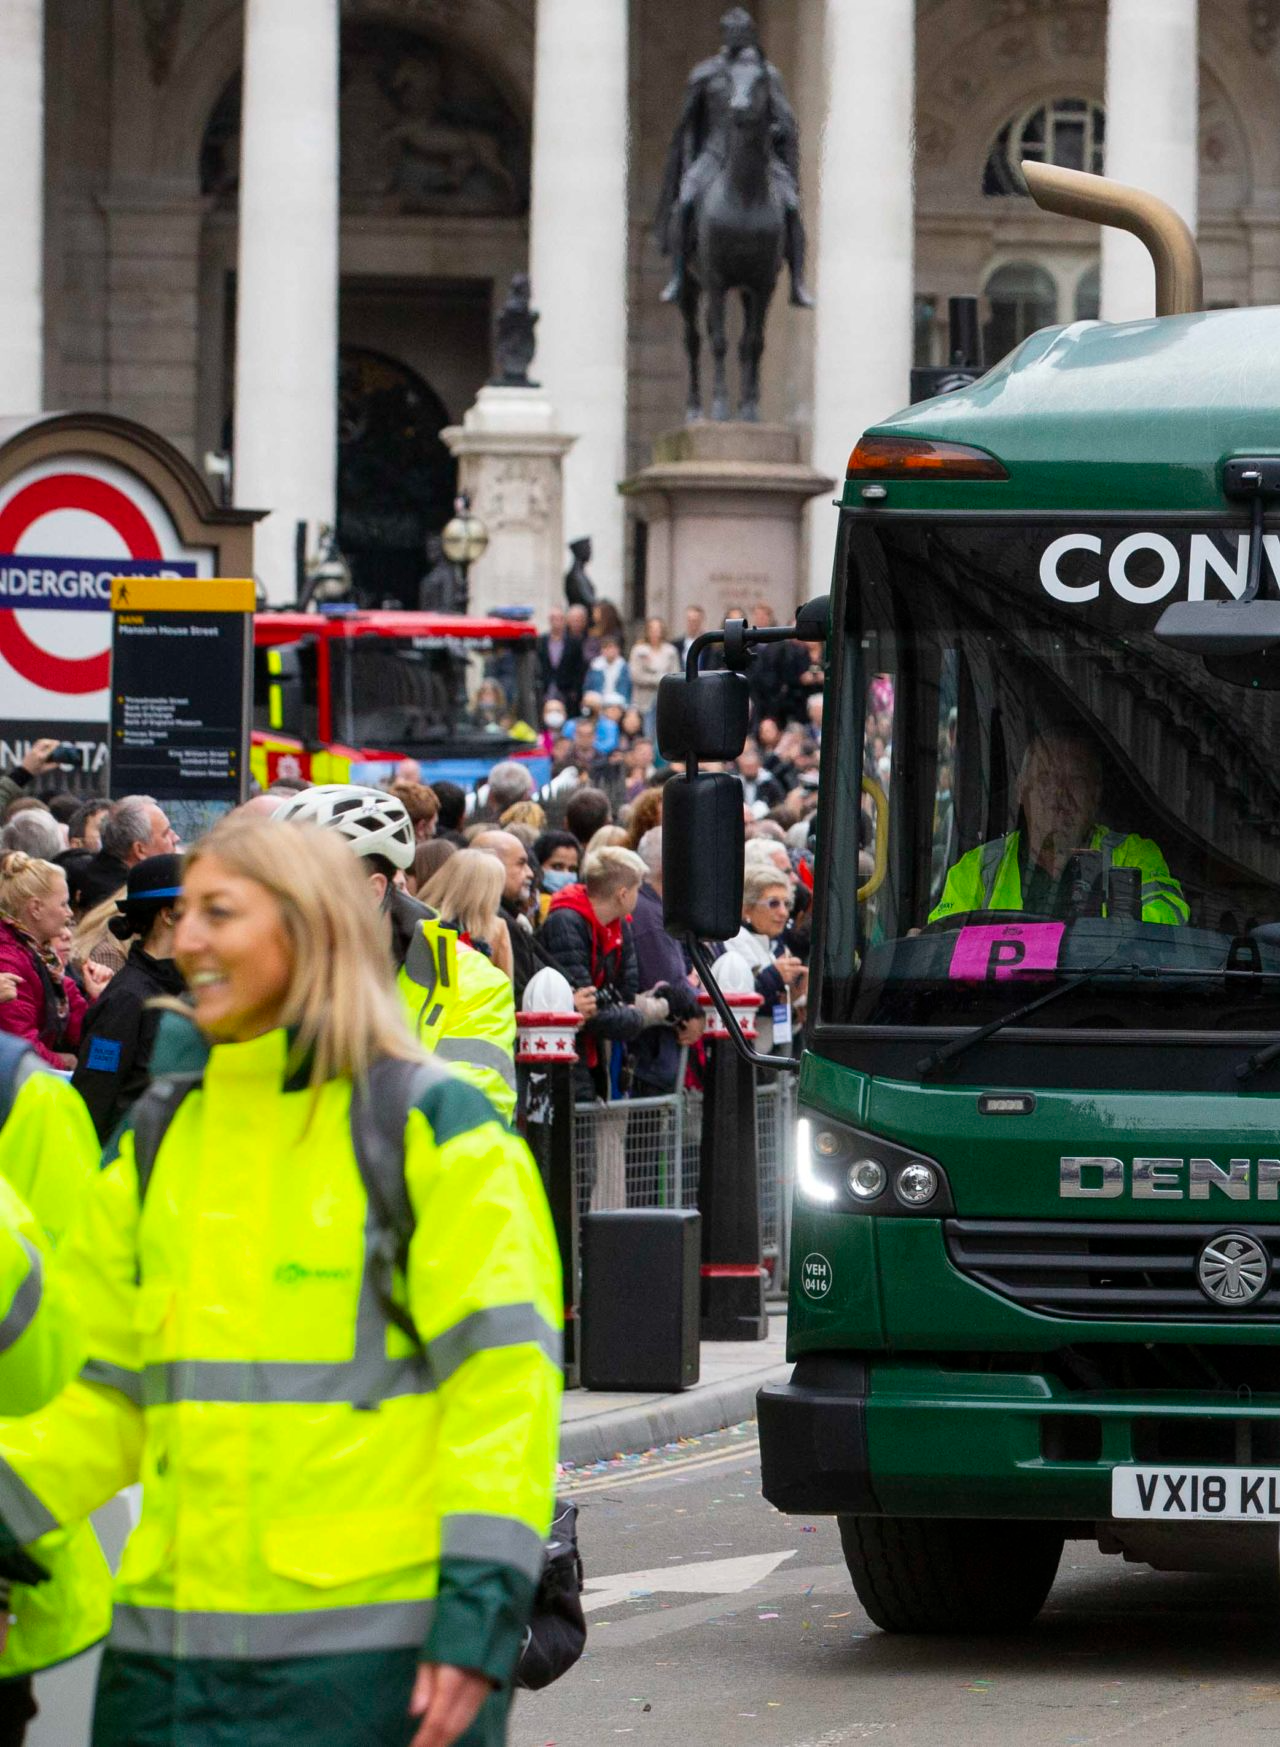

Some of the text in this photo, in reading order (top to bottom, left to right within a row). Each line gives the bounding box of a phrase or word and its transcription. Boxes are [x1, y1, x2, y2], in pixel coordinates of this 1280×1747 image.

[119, 615, 144, 624] BANK
[119, 625, 219, 637] Mansion House Street
[985, 940, 1026, 980] P
[805, 1263, 827, 1276] VEH
[805, 1278, 827, 1291] 0416
[1135, 1474, 1227, 1513] VX18
